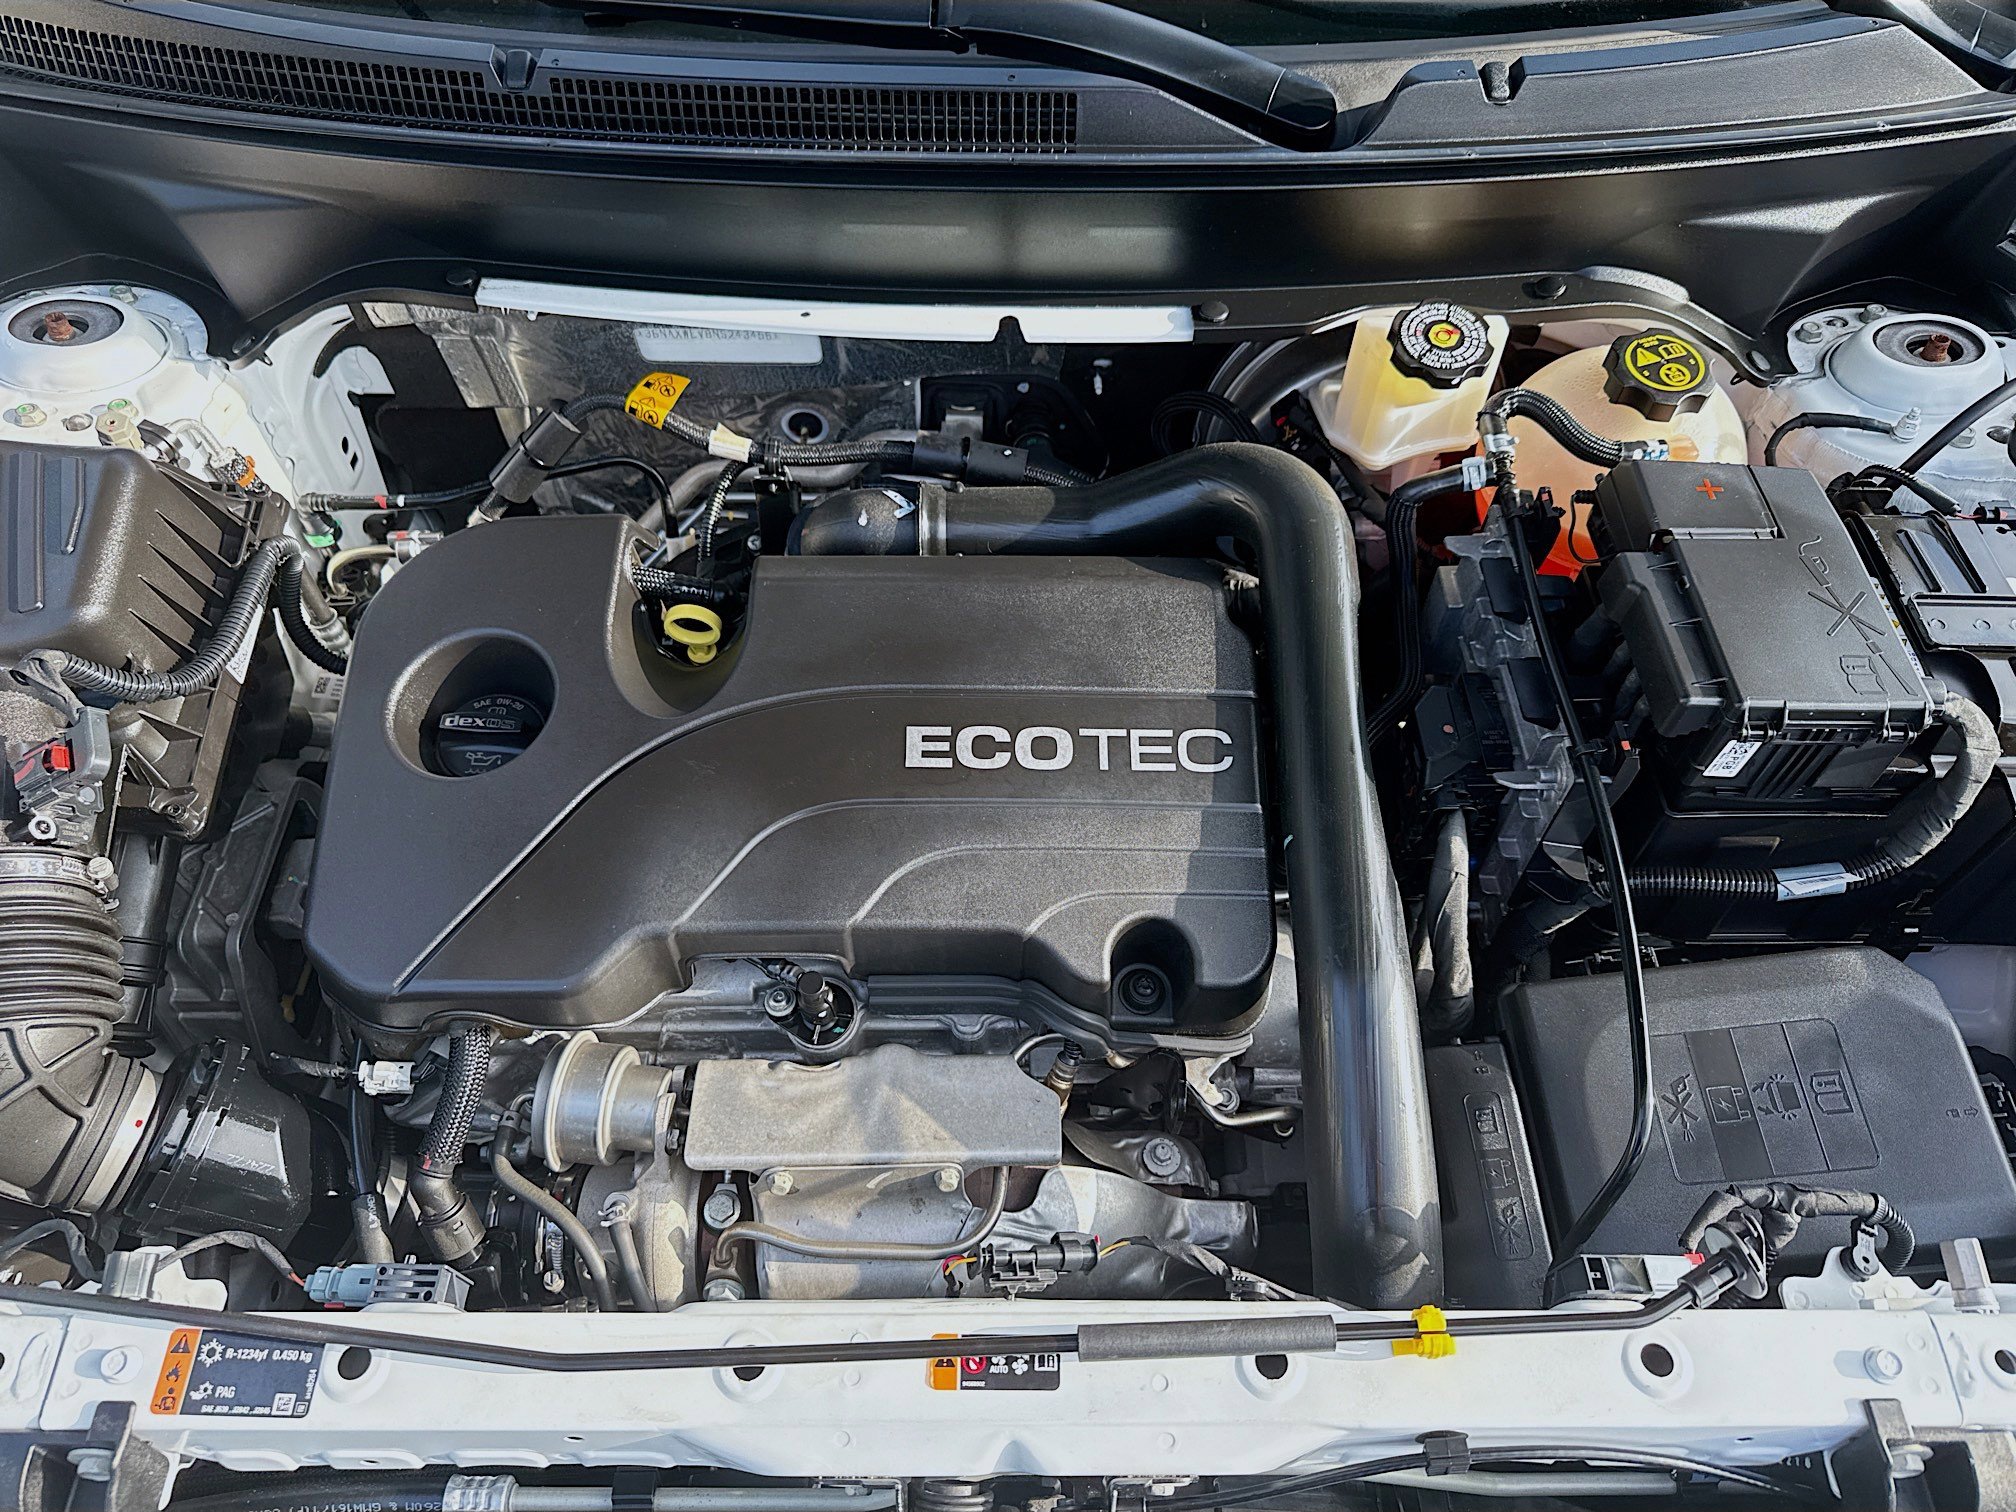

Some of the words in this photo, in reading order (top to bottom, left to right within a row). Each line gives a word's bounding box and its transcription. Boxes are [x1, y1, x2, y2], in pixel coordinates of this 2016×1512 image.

[473, 698, 492, 709] SAE
[496, 698, 525, 711] 0W-20
[444, 715, 516, 729] dexos
[905, 725, 1234, 772] ECOTEC
[225, 1347, 268, 1362] R-1234yf
[272, 1349, 299, 1361] 0.450
[299, 1350, 313, 1363] kg
[989, 1365, 1009, 1374] AUTO
[215, 1386, 236, 1398] PAG
